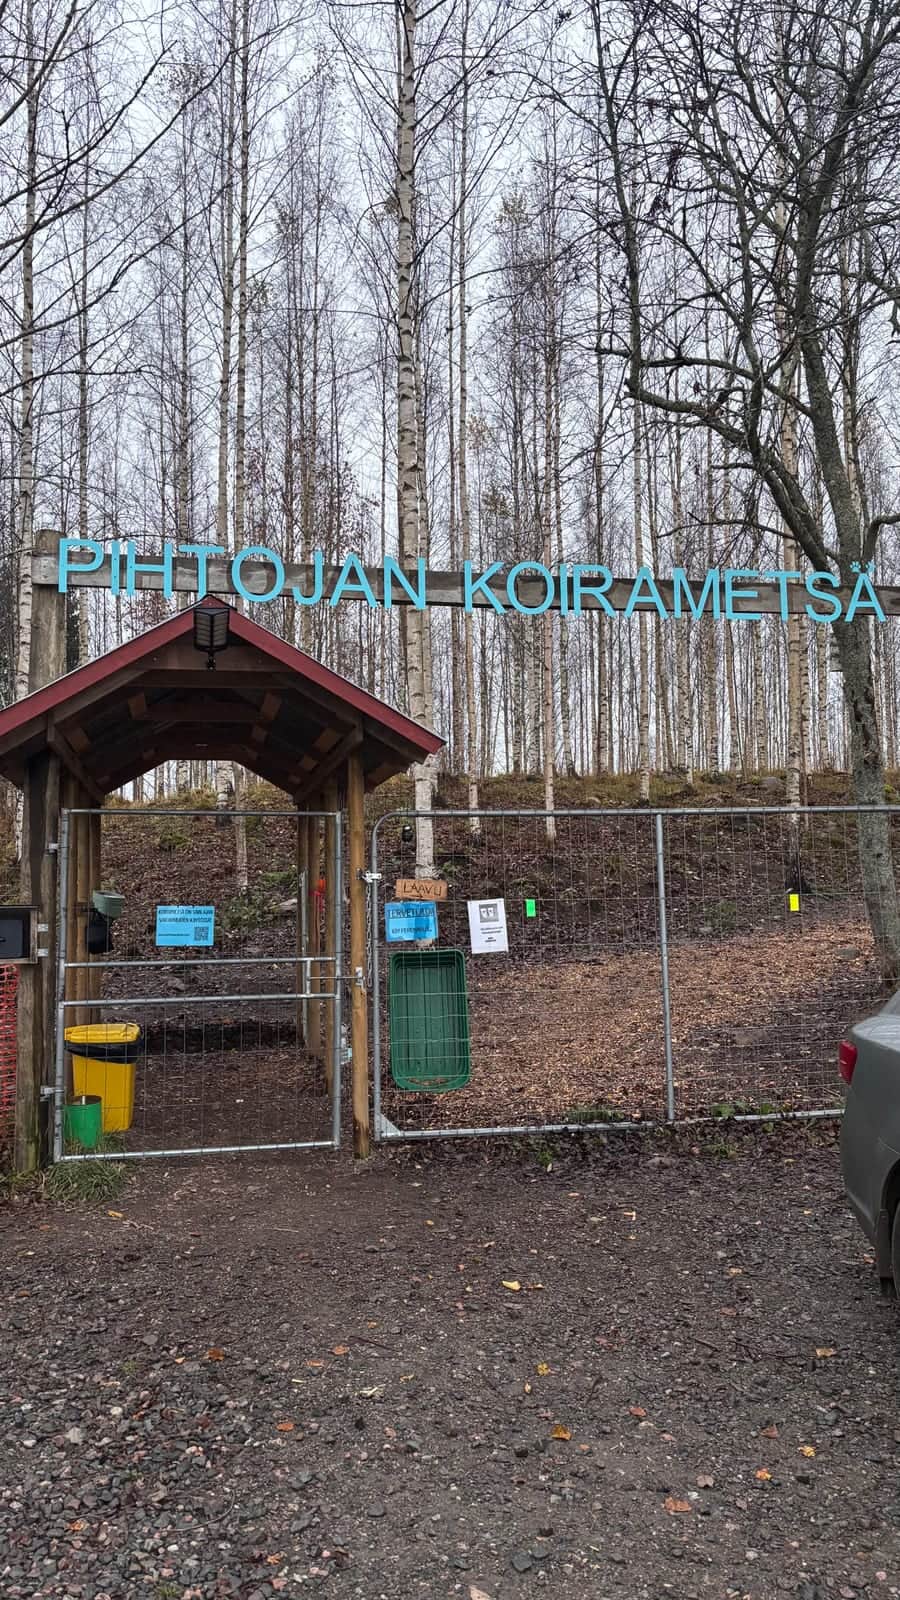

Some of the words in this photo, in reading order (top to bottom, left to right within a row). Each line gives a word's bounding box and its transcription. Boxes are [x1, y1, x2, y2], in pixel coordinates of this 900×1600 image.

[58, 538, 427, 609] PIHTOJAN
[463, 560, 886, 622] KOIRAMETSÄ
[403, 884, 442, 896] LAAVU
